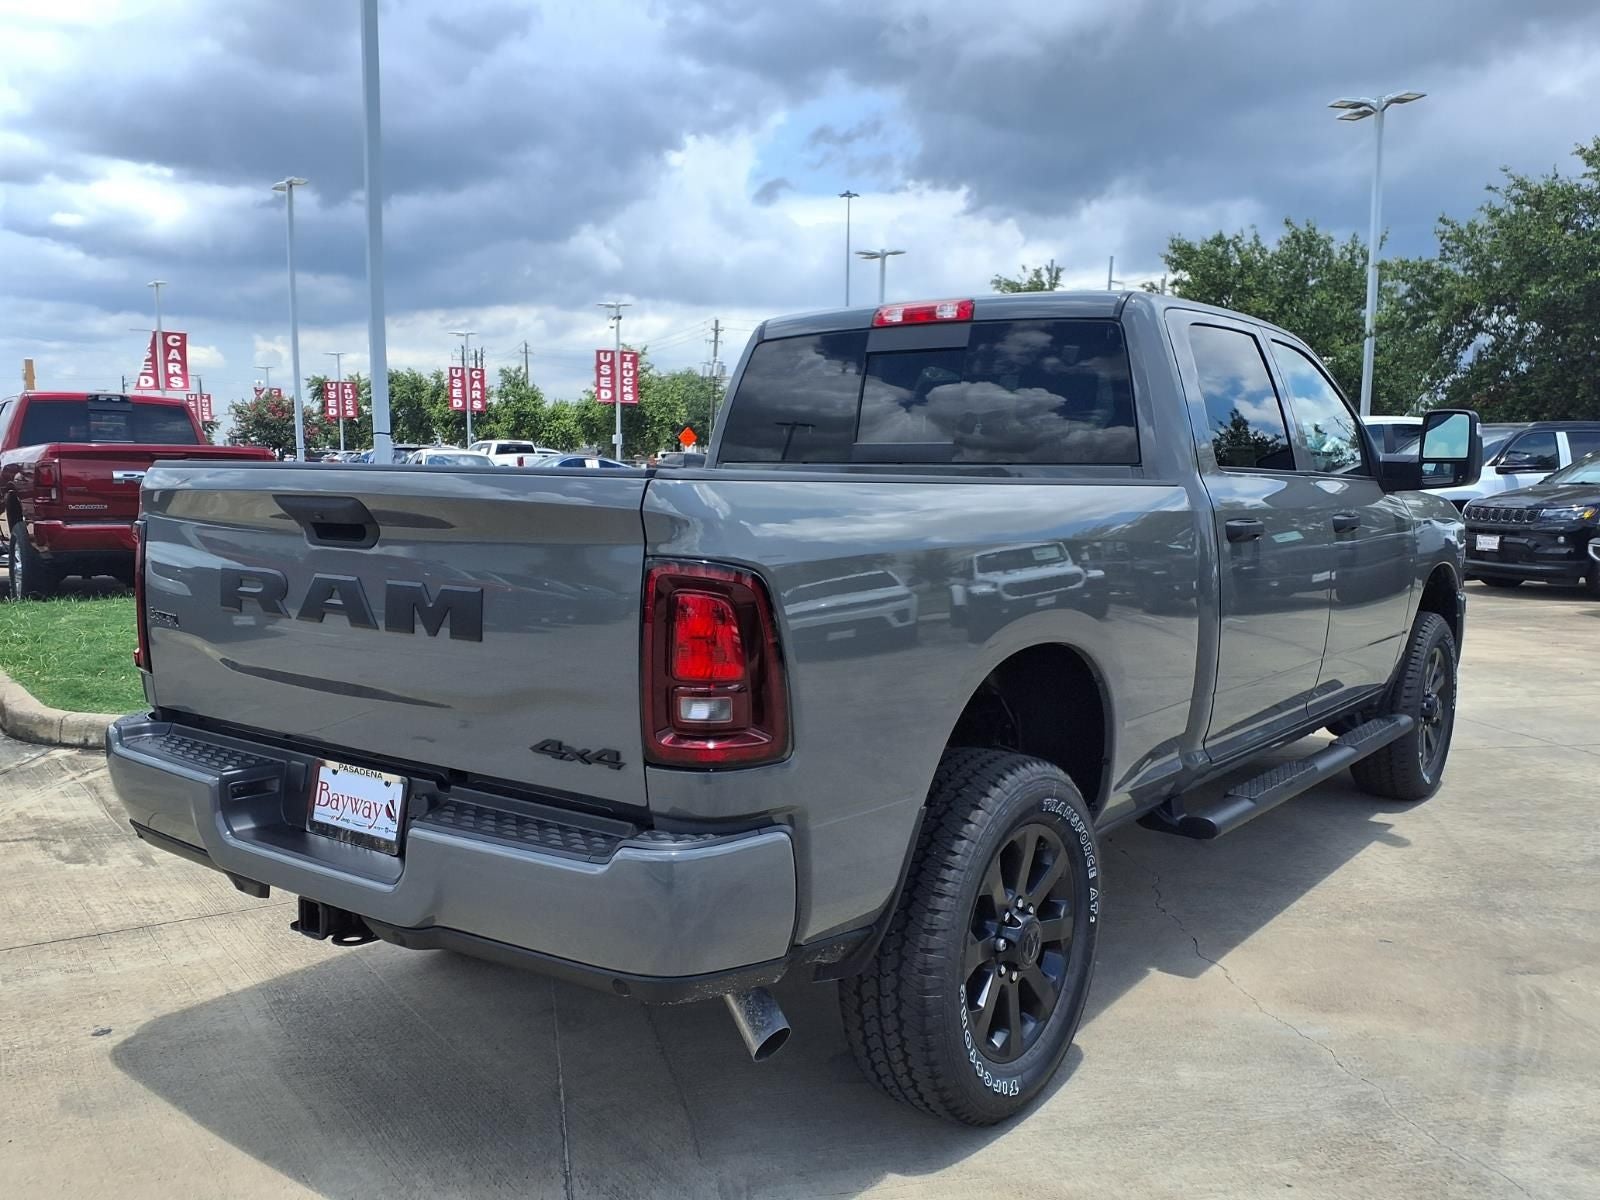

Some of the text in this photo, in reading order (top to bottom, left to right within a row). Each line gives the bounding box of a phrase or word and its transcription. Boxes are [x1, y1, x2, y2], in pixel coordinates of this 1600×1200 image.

[139, 343, 154, 387] SED
[167, 335, 184, 388] CARS
[600, 352, 612, 400] USED
[623, 354, 634, 401] TRUCKS
[327, 383, 338, 416] USED
[344, 383, 354, 416] TRUCKS
[452, 369, 462, 408] USED
[471, 370, 482, 409] CARS
[221, 566, 485, 643] RAM
[338, 763, 383, 780] PASADENA
[316, 780, 383, 830] Bayway
[1042, 798, 1097, 879] TRANSFORCE
